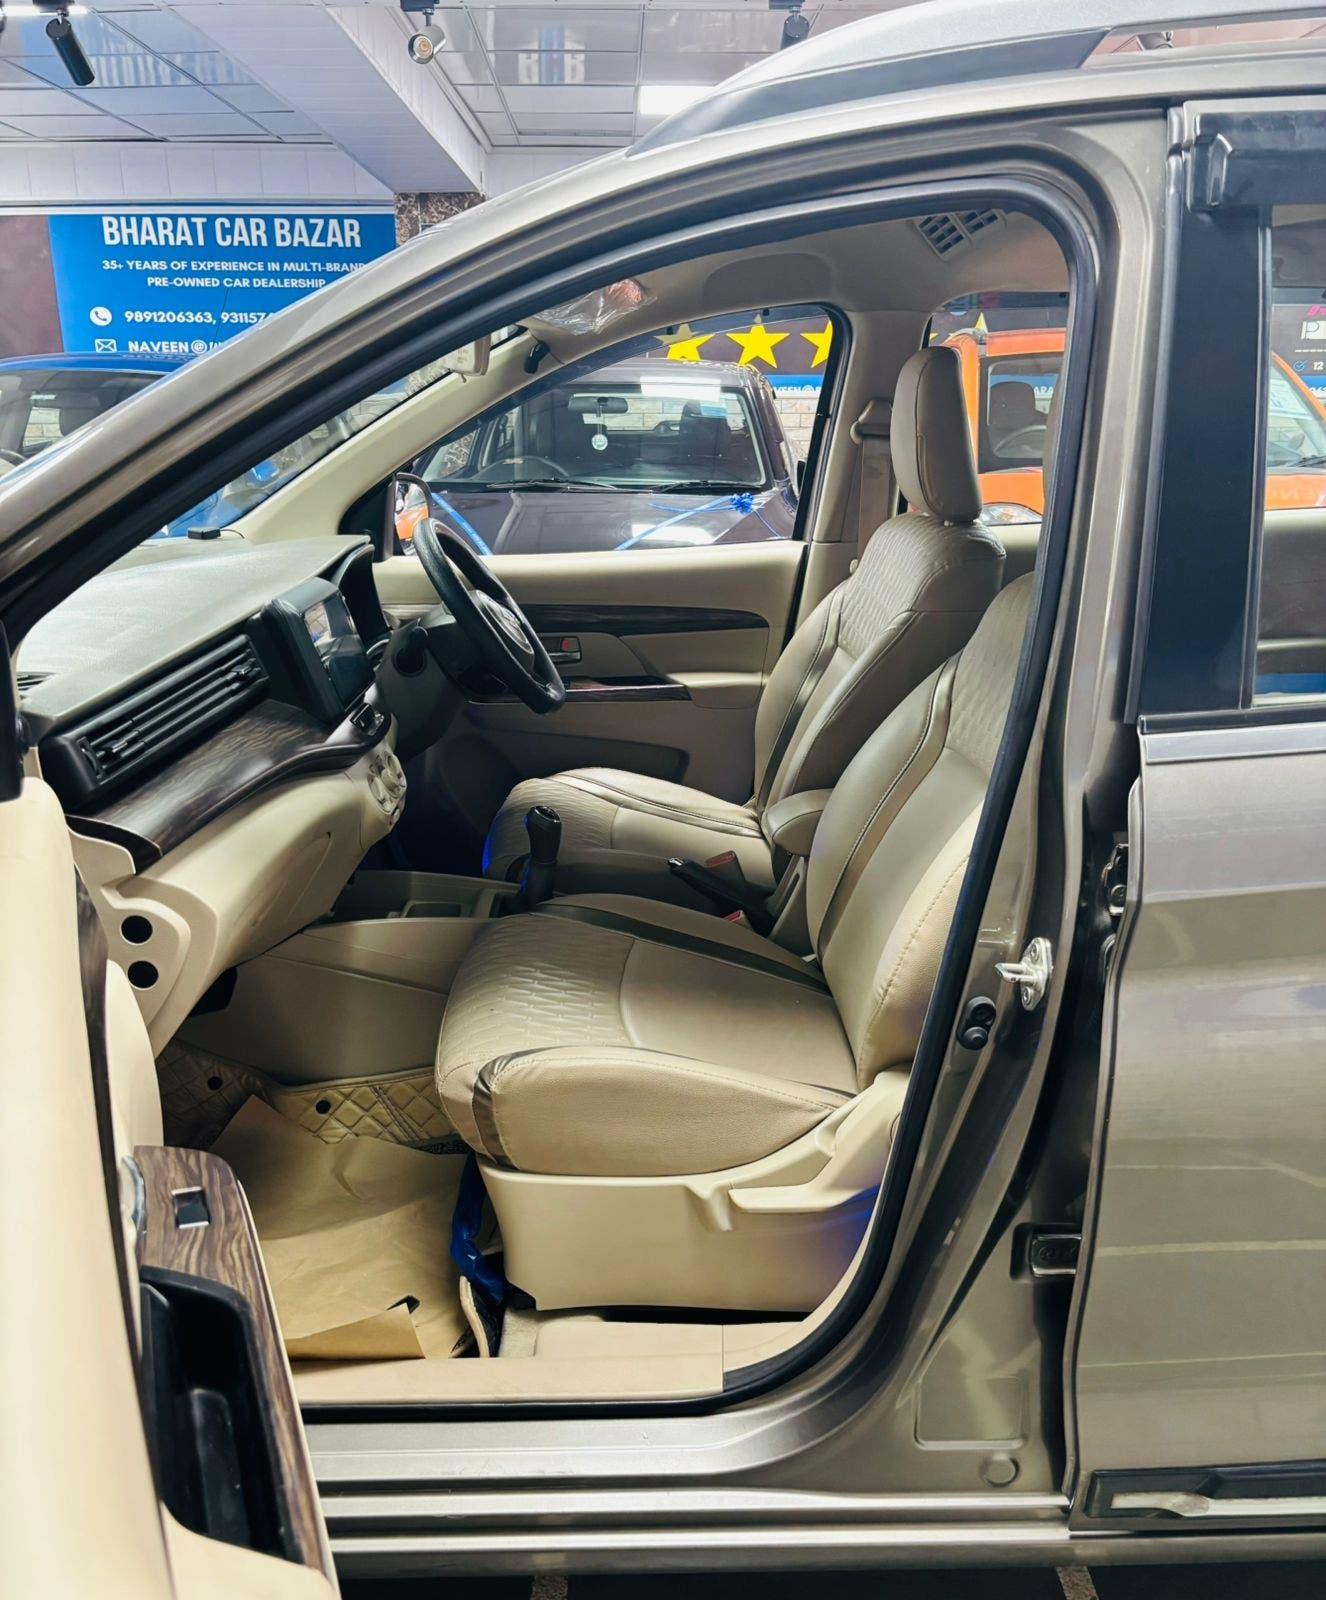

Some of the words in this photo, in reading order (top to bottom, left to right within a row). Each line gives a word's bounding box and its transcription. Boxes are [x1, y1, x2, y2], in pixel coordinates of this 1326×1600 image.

[101, 216, 207, 247] BHARAT
[215, 217, 268, 247] CAR
[274, 218, 362, 248] BAZAR
[102, 260, 124, 270] 35+
[126, 260, 168, 270] YEARS
[170, 261, 188, 271] OF
[191, 261, 264, 271] EXPERIENCE
[267, 262, 280, 272] IN
[147, 277, 220, 287] PRE-OWNED
[223, 278, 250, 288] CAR
[253, 278, 326, 289] DEALERSHIP
[124, 311, 217, 325] 9891206363,
[221, 311, 273, 324] 931157
